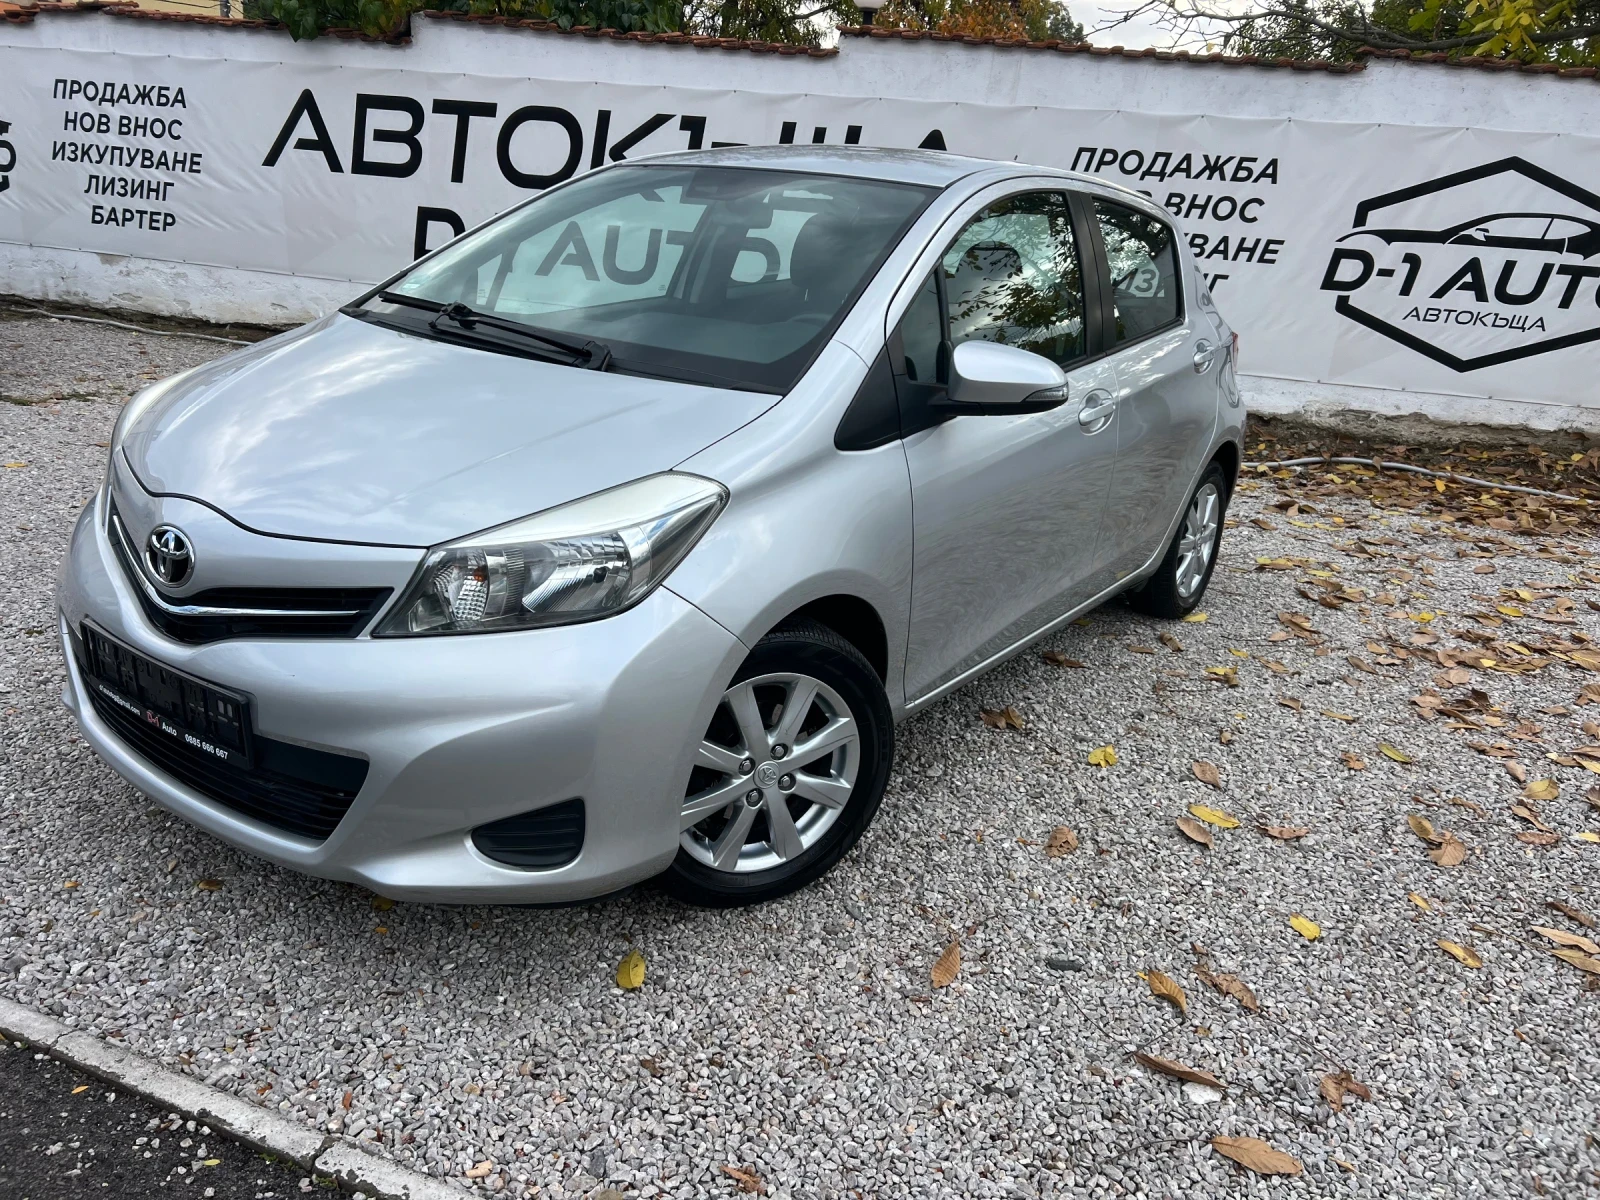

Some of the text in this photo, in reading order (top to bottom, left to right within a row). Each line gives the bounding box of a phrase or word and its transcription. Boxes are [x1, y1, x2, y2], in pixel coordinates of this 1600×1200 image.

[53, 79, 187, 108] ПРОДАЖБА
[64, 111, 182, 140] НОВ ВНОС
[262, 88, 947, 190] АВТОК
[51, 141, 202, 173] ИЗКУПУВАНЕ
[1070, 147, 1279, 184] ПРОДАЖБА
[84, 175, 175, 201] ЛИЗИНГ
[91, 205, 176, 231] БАРТЕР
[1164, 192, 1265, 223] ВНОС
[1320, 248, 1600, 309] D-1 AUT
[1402, 307, 1546, 332] АВТОКЪЩА
[162, 722, 177, 736] Auto
